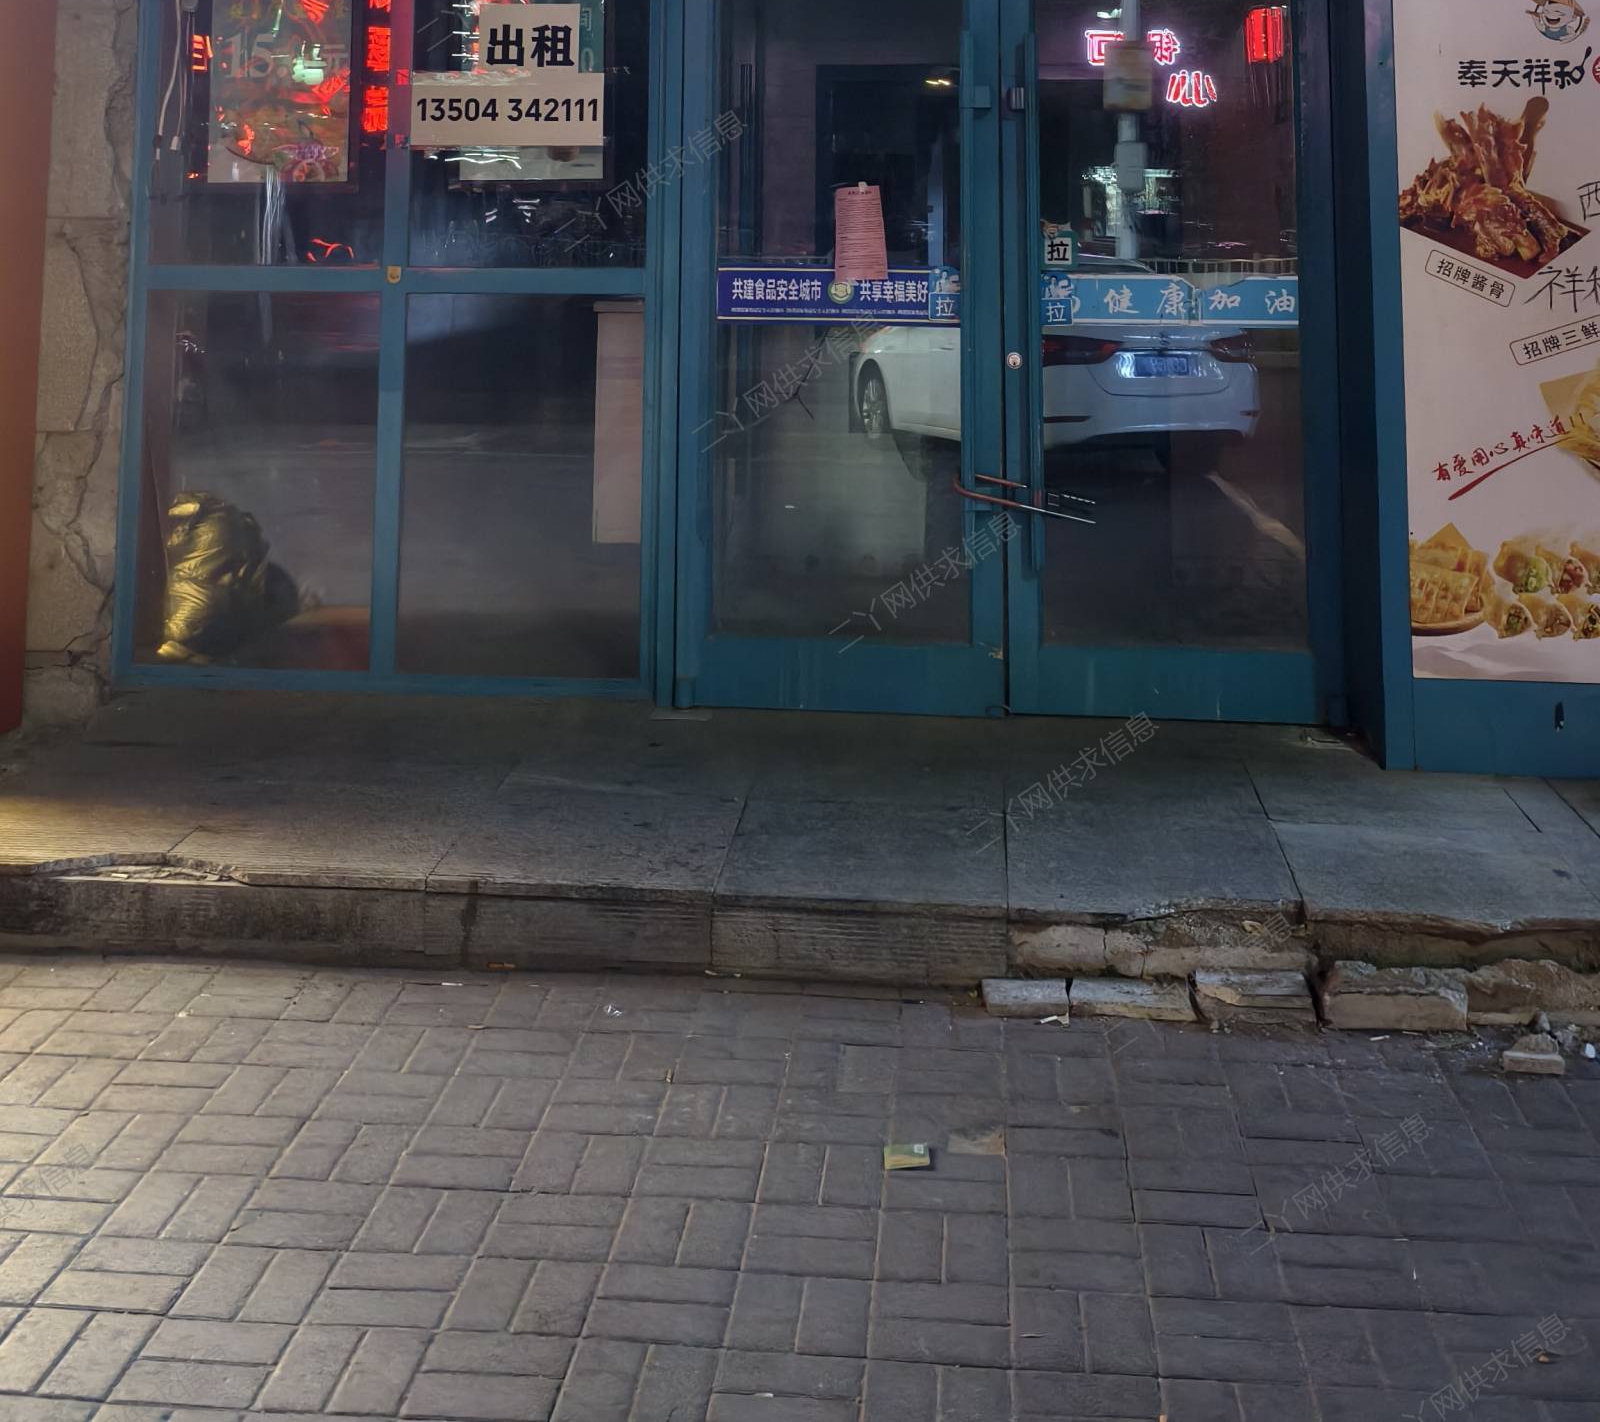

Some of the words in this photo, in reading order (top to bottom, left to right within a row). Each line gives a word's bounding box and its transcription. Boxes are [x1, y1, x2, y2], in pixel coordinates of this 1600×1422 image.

[486, 24, 575, 67] 出租
[1458, 46, 1592, 95] 奉天祥和
[416, 97, 499, 122] 13504
[507, 97, 599, 122] 342111
[1047, 240, 1070, 262] 拉
[731, 278, 822, 302] 共建食品安全城市
[859, 280, 929, 304] 共享幸福美好
[1073, 281, 1296, 316] 健康加油
[935, 297, 955, 317] 拉
[1046, 302, 1067, 323] 拉
